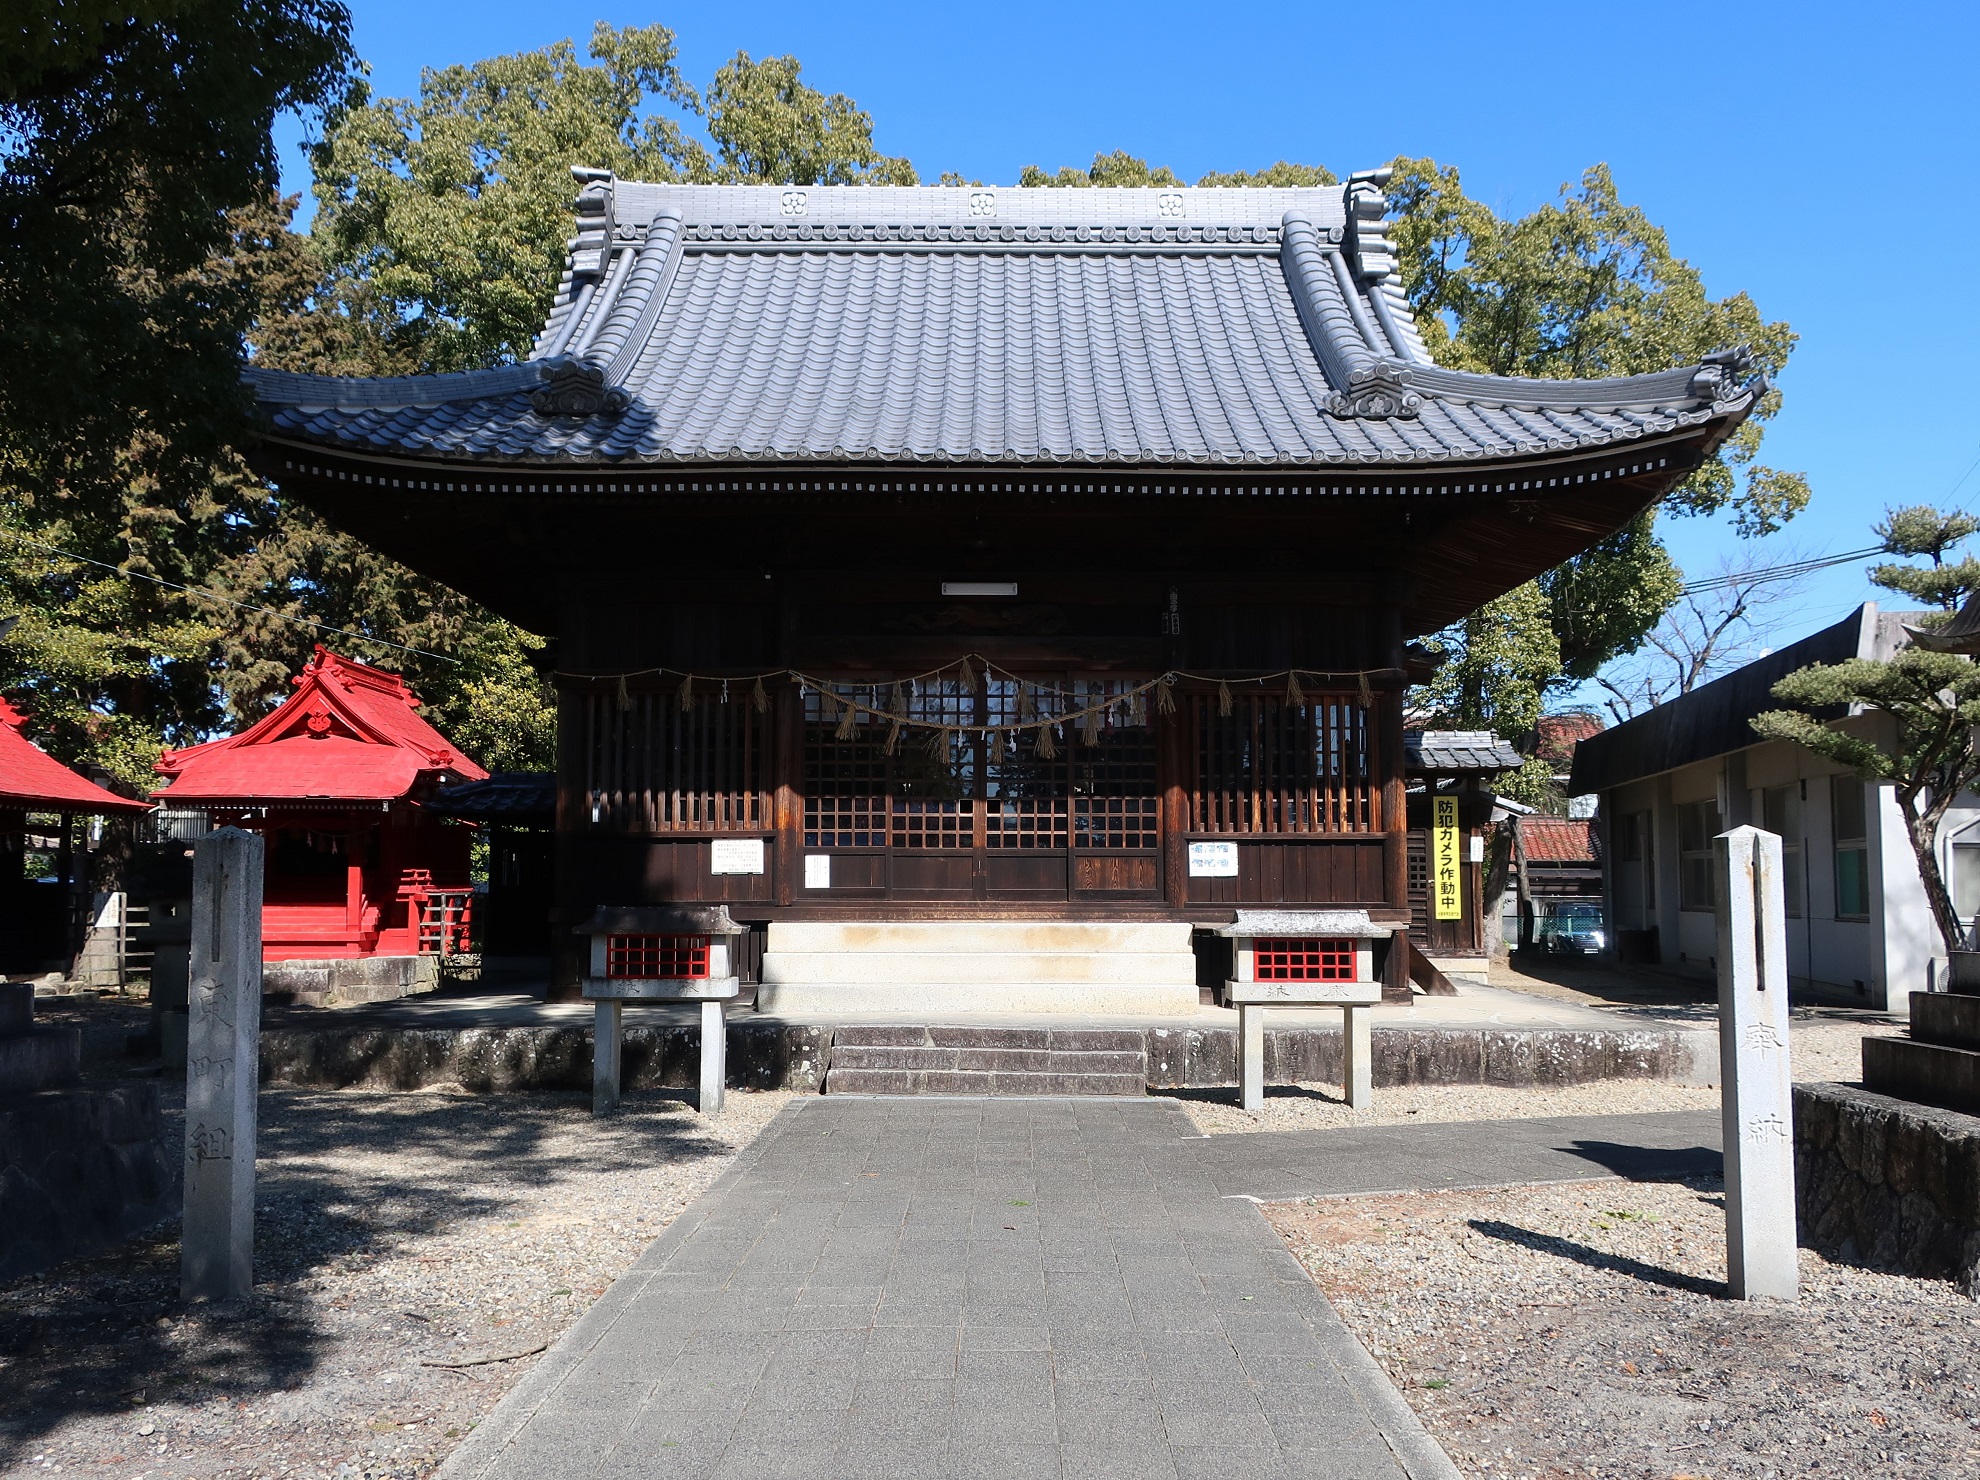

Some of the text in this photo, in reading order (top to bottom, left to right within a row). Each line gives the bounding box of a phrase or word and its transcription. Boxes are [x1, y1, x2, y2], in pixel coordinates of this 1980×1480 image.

[1438, 800, 1455, 910] 防犯カメラ作動中
[189, 977, 234, 1163] 東町組
[1740, 1021, 1788, 1144] 奉納
